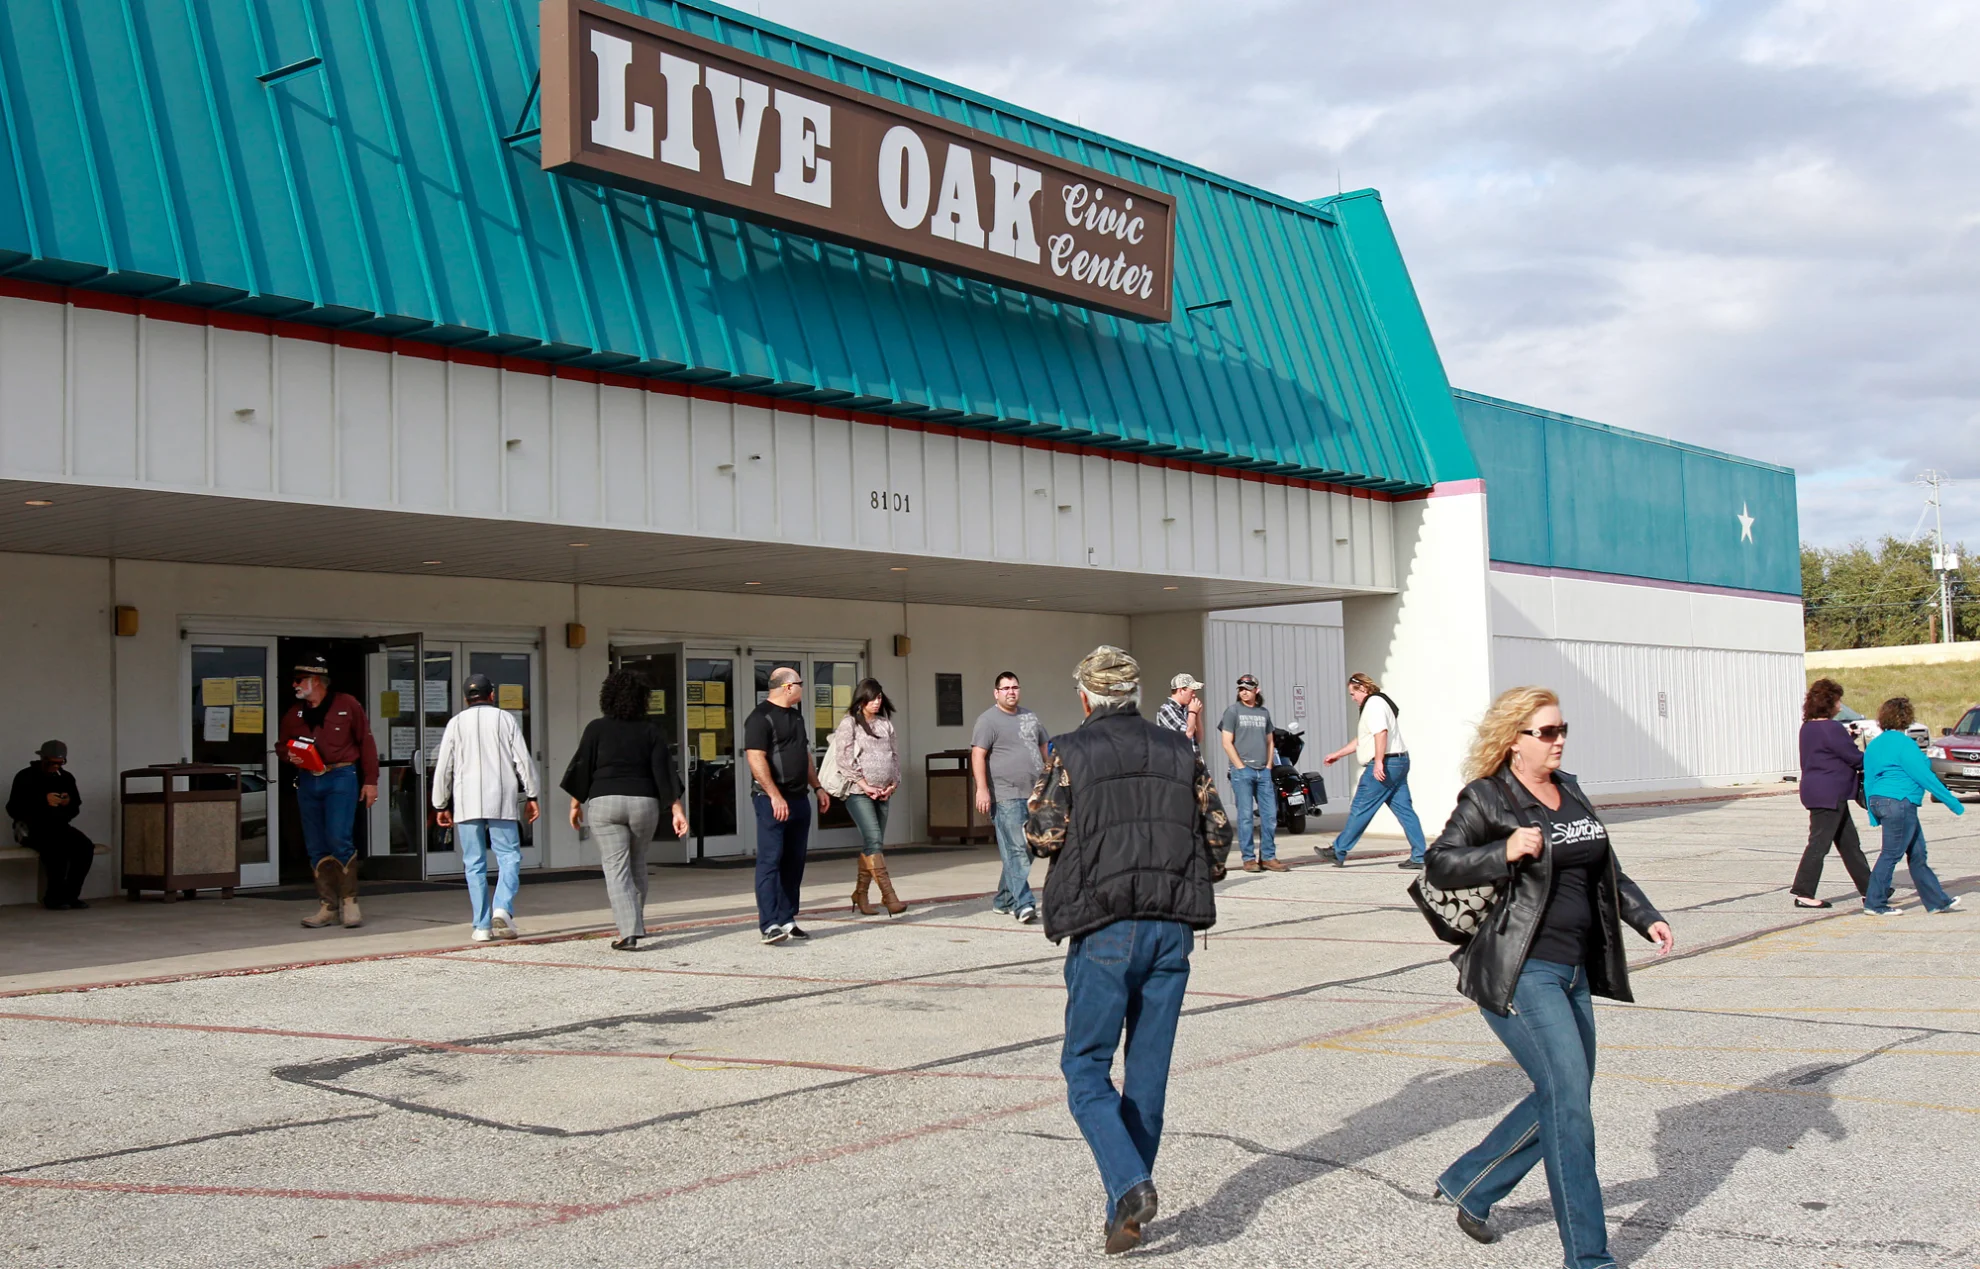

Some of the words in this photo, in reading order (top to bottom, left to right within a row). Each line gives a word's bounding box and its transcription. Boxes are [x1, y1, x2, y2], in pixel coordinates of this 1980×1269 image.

[590, 29, 831, 208] LIVE
[878, 125, 1042, 264] OAK
[1062, 183, 1144, 244] Civic
[1048, 233, 1153, 299] Center
[871, 491, 910, 512] 8101
